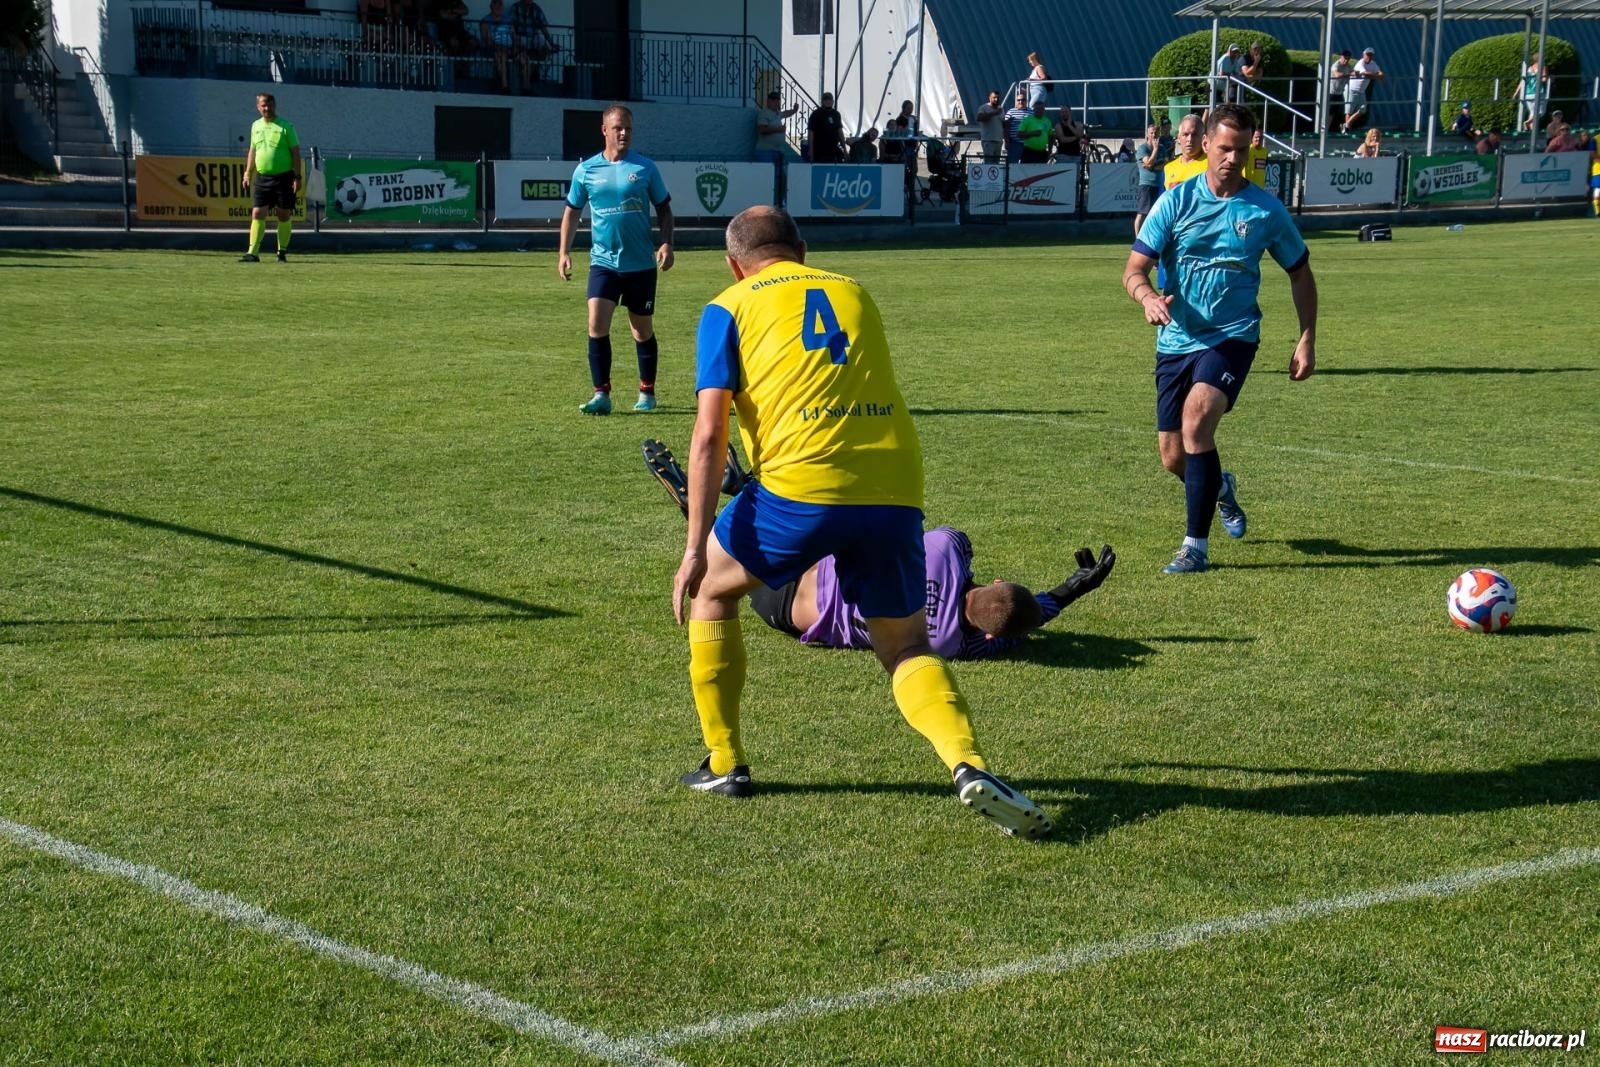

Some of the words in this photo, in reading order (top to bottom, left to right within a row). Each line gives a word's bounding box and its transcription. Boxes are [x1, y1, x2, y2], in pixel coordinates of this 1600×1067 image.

[368, 174, 405, 187] FRANZ
[822, 172, 873, 199] Hedo
[1330, 167, 1373, 187] żabka
[382, 184, 446, 203] DROBNY
[144, 206, 175, 216] ROBOTY
[178, 206, 208, 217] ZIEMNE
[802, 288, 851, 365] 4
[825, 404, 862, 418] Sokol
